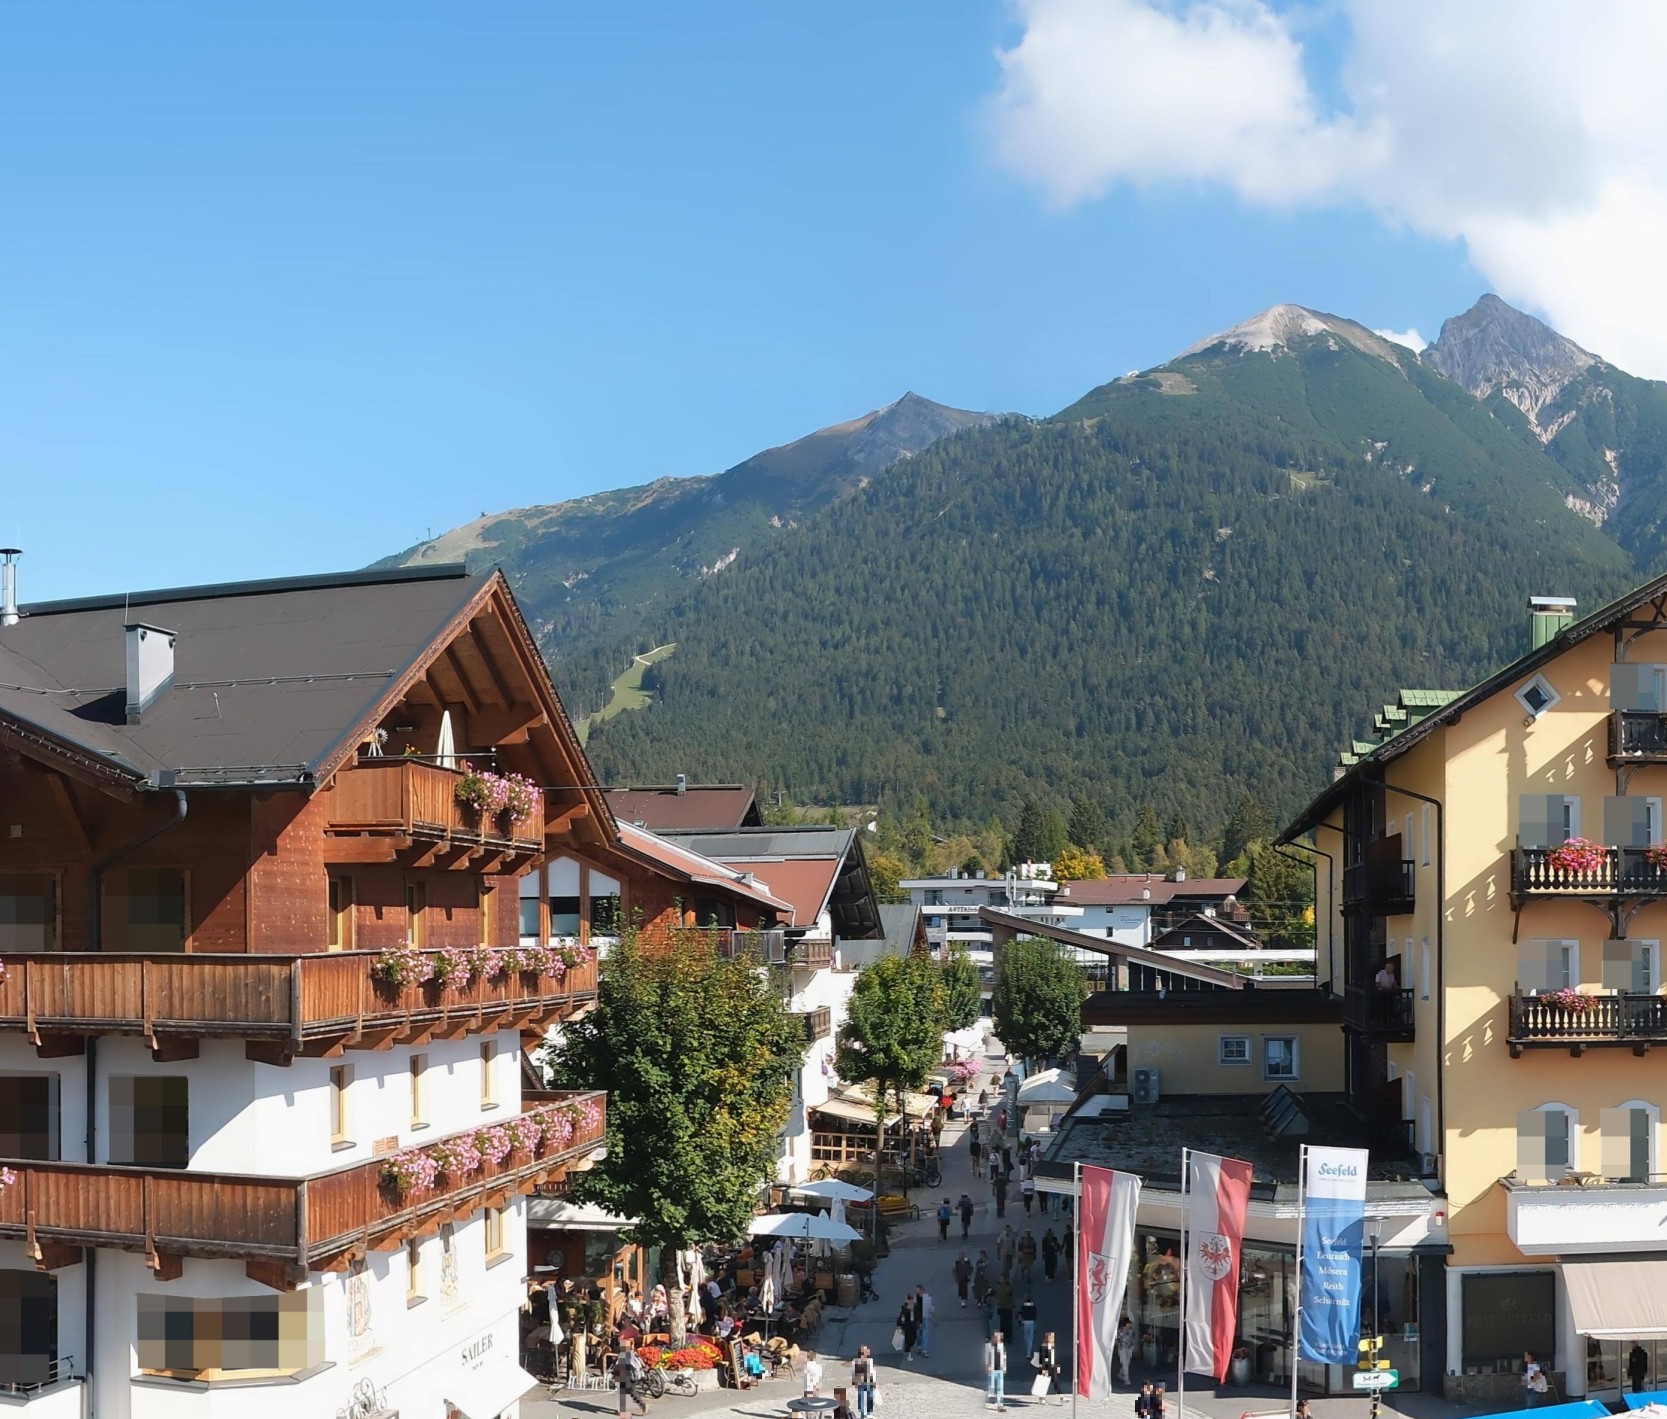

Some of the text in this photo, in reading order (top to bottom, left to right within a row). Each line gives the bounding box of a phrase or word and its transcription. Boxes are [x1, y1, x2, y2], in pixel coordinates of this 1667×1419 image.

[1318, 1162, 1358, 1178] Seefeld
[1318, 1265, 1348, 1276] Mösern
[1323, 1281, 1344, 1291] Reith
[461, 1332, 493, 1367] SAILER
